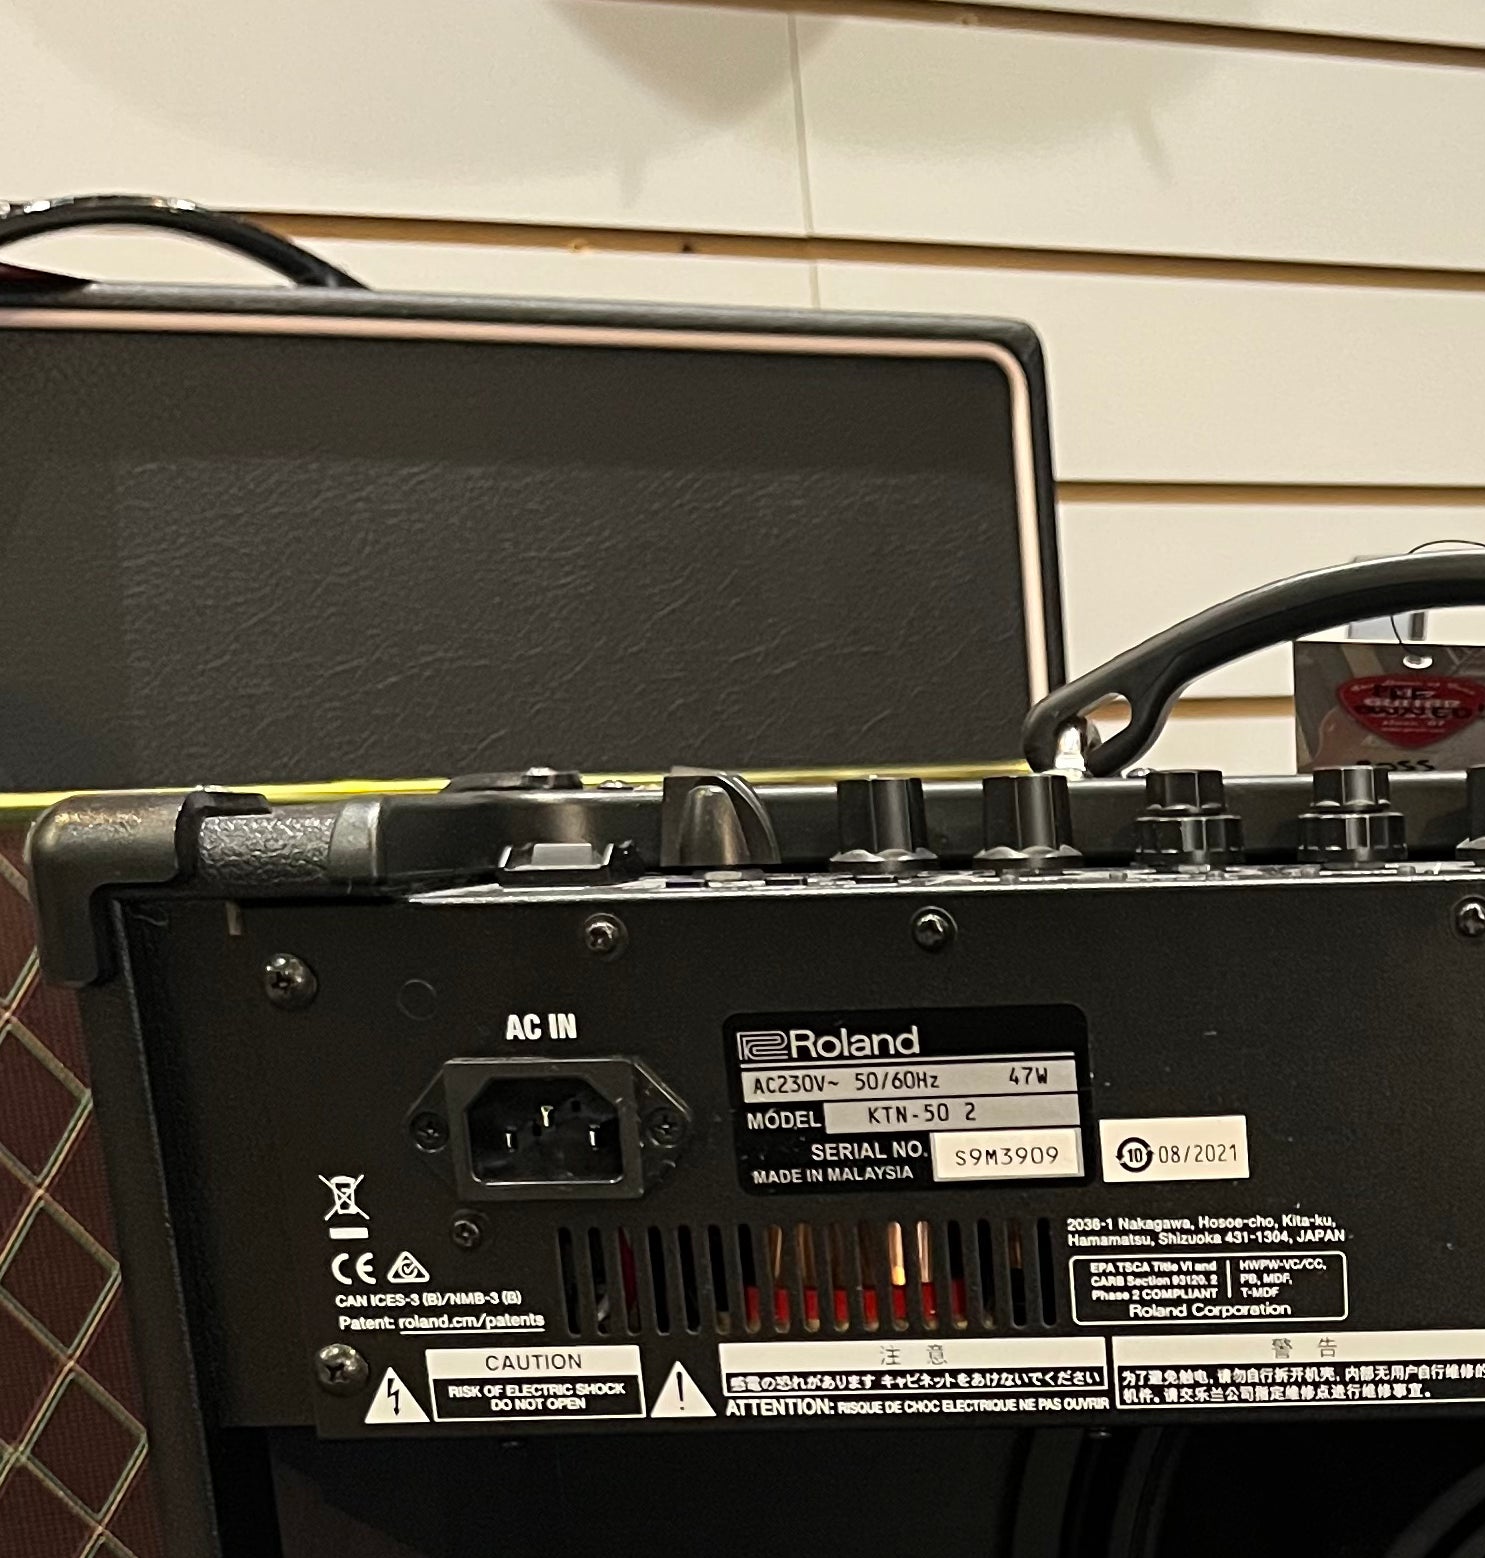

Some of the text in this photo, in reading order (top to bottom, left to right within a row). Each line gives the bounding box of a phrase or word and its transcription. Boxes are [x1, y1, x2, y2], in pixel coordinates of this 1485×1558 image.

[506, 1014, 577, 1040] AC IN
[790, 1026, 919, 1058] Roland
[855, 1072, 940, 1091] 50/60Hz
[1010, 1067, 1048, 1085] 47W
[747, 1102, 976, 1130] MODEL KTN-50 2
[812, 1140, 1059, 1166] SERIAL NO. S9M3909
[1128, 1148, 1142, 1162] 10
[1158, 1144, 1237, 1164] 08/2021
[753, 1166, 913, 1184] MADE IN MALAYSIA
[1118, 1218, 1194, 1232] Nakagawa,
[1282, 1214, 1336, 1228] Kita-ku,
[1068, 1229, 1345, 1248] Hamamatsu, Shizuoka 431-1304, JAPAN
[1090, 1262, 1114, 1273] EPA
[1118, 1262, 1150, 1272] TSCA
[1194, 1261, 1216, 1271] and
[1127, 1276, 1170, 1286] Section
[1264, 1274, 1292, 1285] MDF,
[336, 1295, 367, 1308] CAN
[370, 1294, 420, 1306] ICES-3
[502, 1290, 522, 1305] (B)
[1092, 1288, 1218, 1300] Phase 2 COMPLIANT
[1240, 1288, 1279, 1298] T-MDF
[1130, 1302, 1292, 1318] Roland Corporation
[338, 1313, 545, 1330] Patent: roland.cm/patents
[486, 1354, 582, 1372] CAUTION
[448, 1381, 625, 1398] RISK OF ELECTRIC SHOCK
[491, 1397, 585, 1411] DO NOT OPEN
[726, 1398, 834, 1416] ATTENTION:
[838, 1402, 883, 1414] RISQUE
[885, 1401, 902, 1414] DE
[904, 1400, 941, 1413] CHOC
[942, 1399, 1018, 1412] ELECTRIQUE
[1019, 1398, 1036, 1411] NE
[1038, 1398, 1062, 1410] PAS
